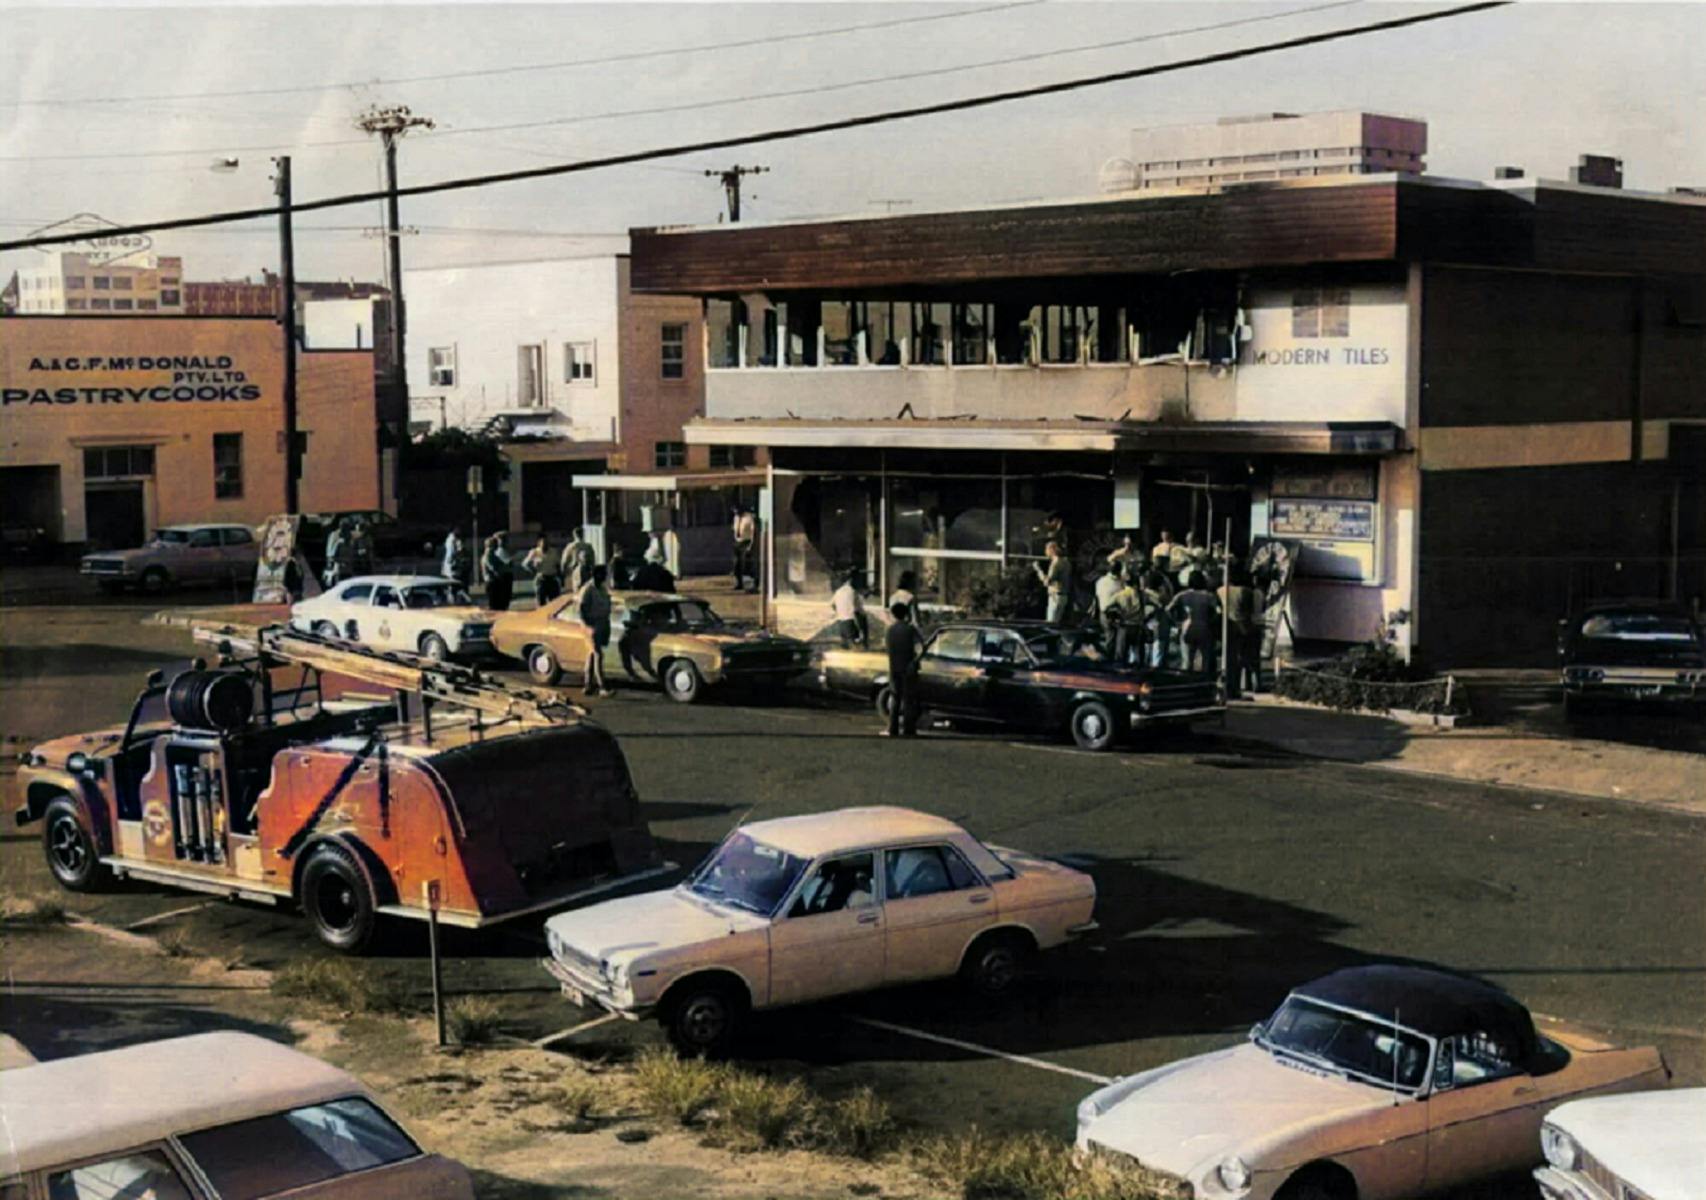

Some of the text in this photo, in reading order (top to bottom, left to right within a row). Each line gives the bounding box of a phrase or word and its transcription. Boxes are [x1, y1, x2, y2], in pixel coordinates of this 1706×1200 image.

[1252, 347, 1389, 365] MODERN TILES
[1, 386, 261, 405] PASTRYCOOKS
